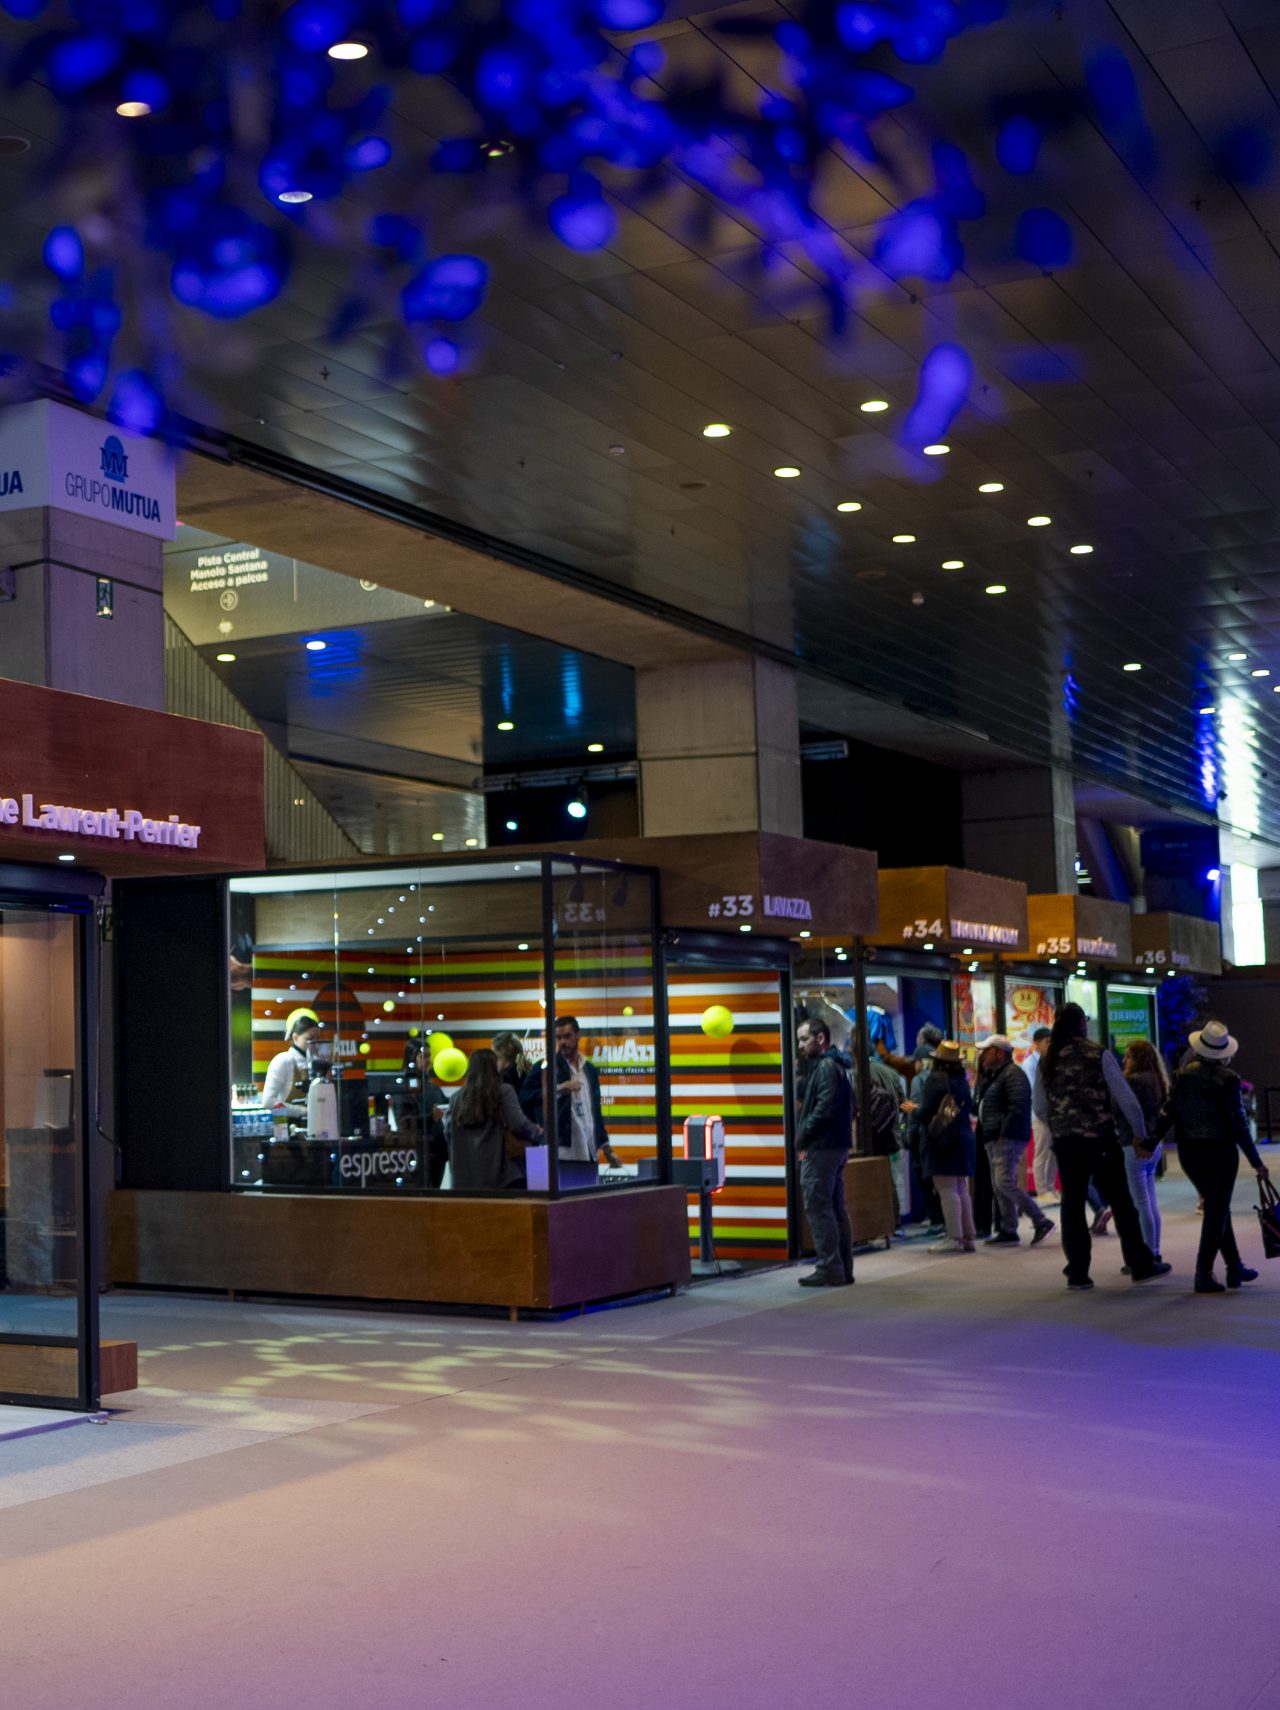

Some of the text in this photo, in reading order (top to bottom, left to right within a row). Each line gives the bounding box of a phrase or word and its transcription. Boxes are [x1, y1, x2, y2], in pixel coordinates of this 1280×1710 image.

[198, 548, 260, 567] Pista Central
[190, 560, 268, 580] Manolo Santana
[190, 572, 268, 592] Acceso a palcos
[22, 793, 201, 849] Laurent-Perrier
[708, 894, 754, 918] #33
[902, 918, 943, 939] #34
[1036, 936, 1071, 955] #35
[1135, 950, 1166, 965] #36
[591, 1039, 655, 1063] LAVAZZ
[339, 1150, 417, 1189] espresso
